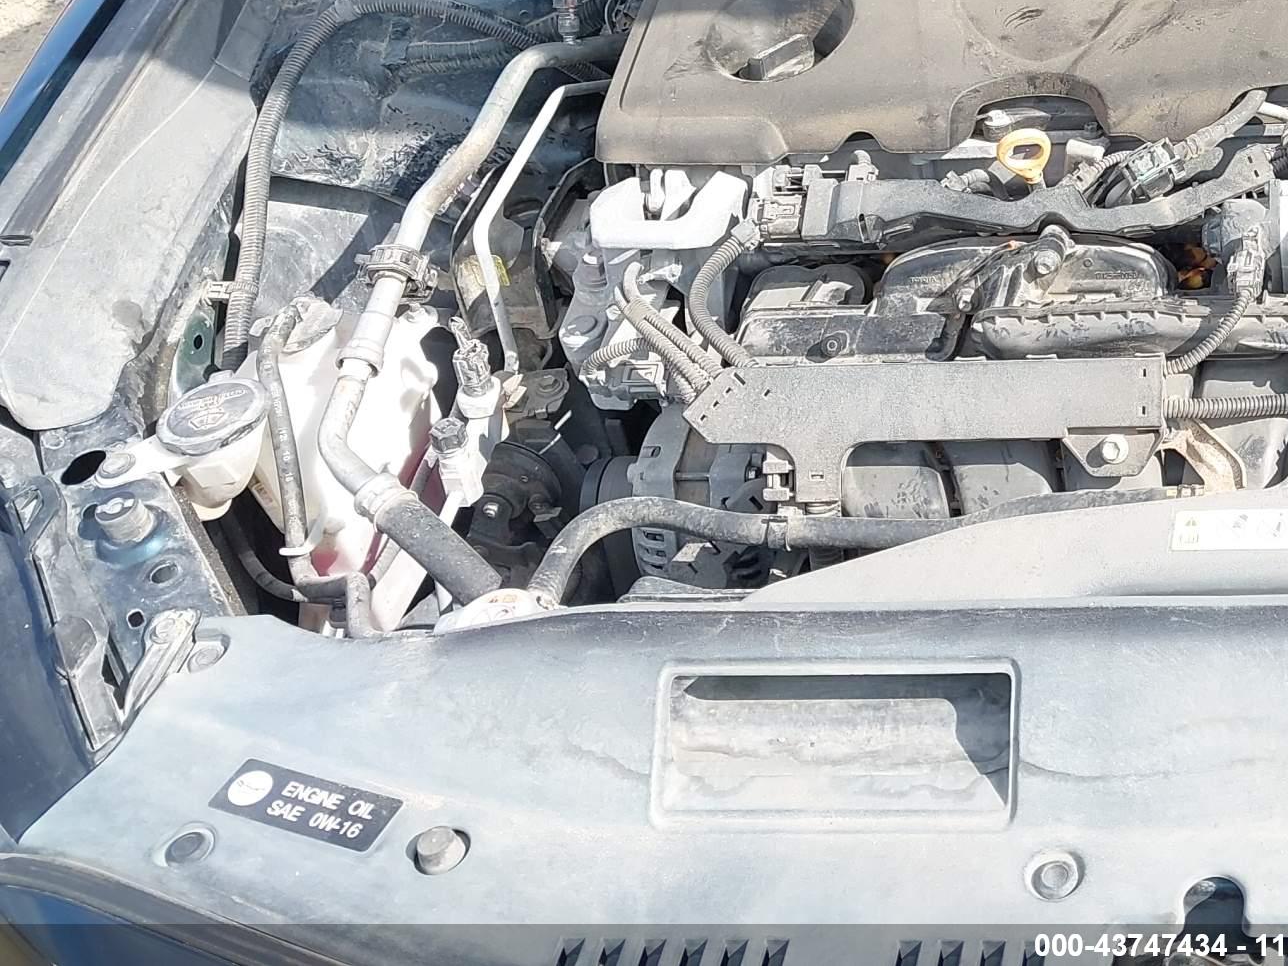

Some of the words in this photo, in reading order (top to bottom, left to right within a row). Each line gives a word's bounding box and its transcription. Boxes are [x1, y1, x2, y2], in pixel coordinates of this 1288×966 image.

[266, 799, 305, 822] SAE
[308, 812, 363, 839] 0W-16
[281, 780, 344, 811] ENGINE
[348, 800, 373, 820] OIL
